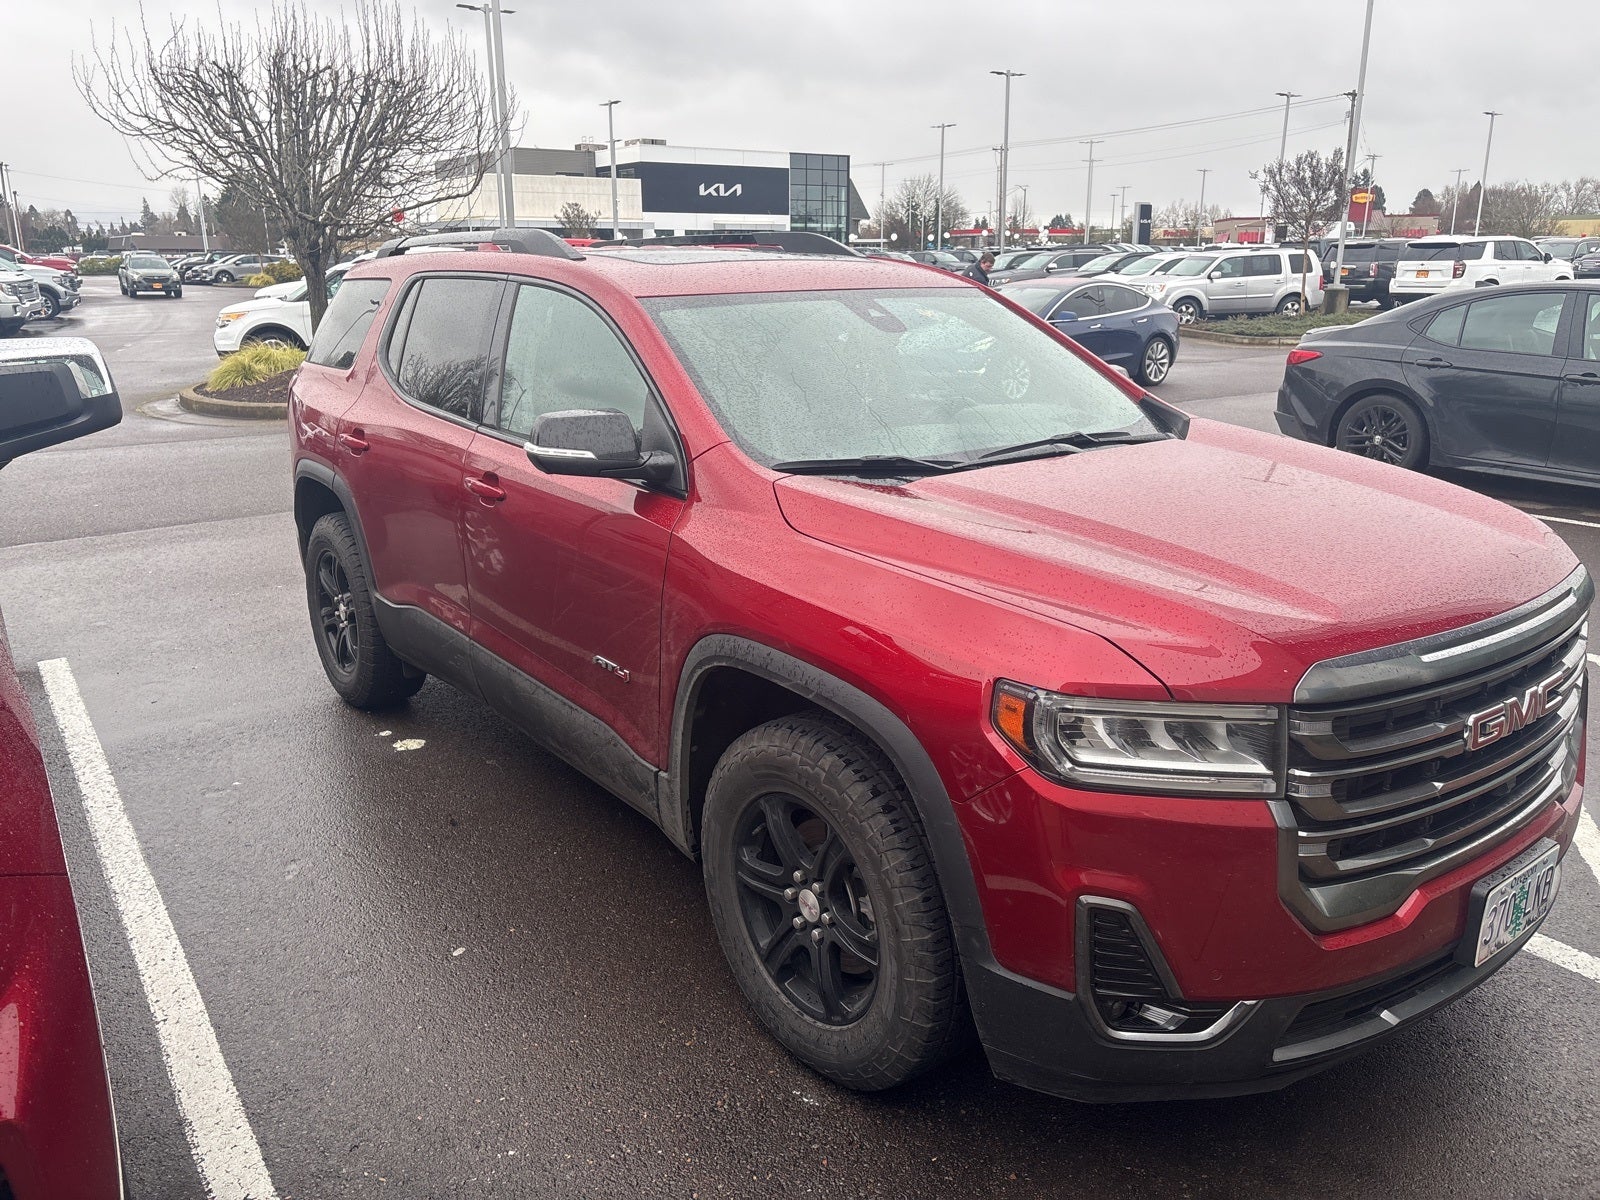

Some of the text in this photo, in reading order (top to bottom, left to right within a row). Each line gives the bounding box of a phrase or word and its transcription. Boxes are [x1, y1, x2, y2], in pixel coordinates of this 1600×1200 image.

[699, 182, 742, 197] KIA
[1464, 671, 1563, 751] GMC
[1483, 865, 1555, 946] 370 LKB
